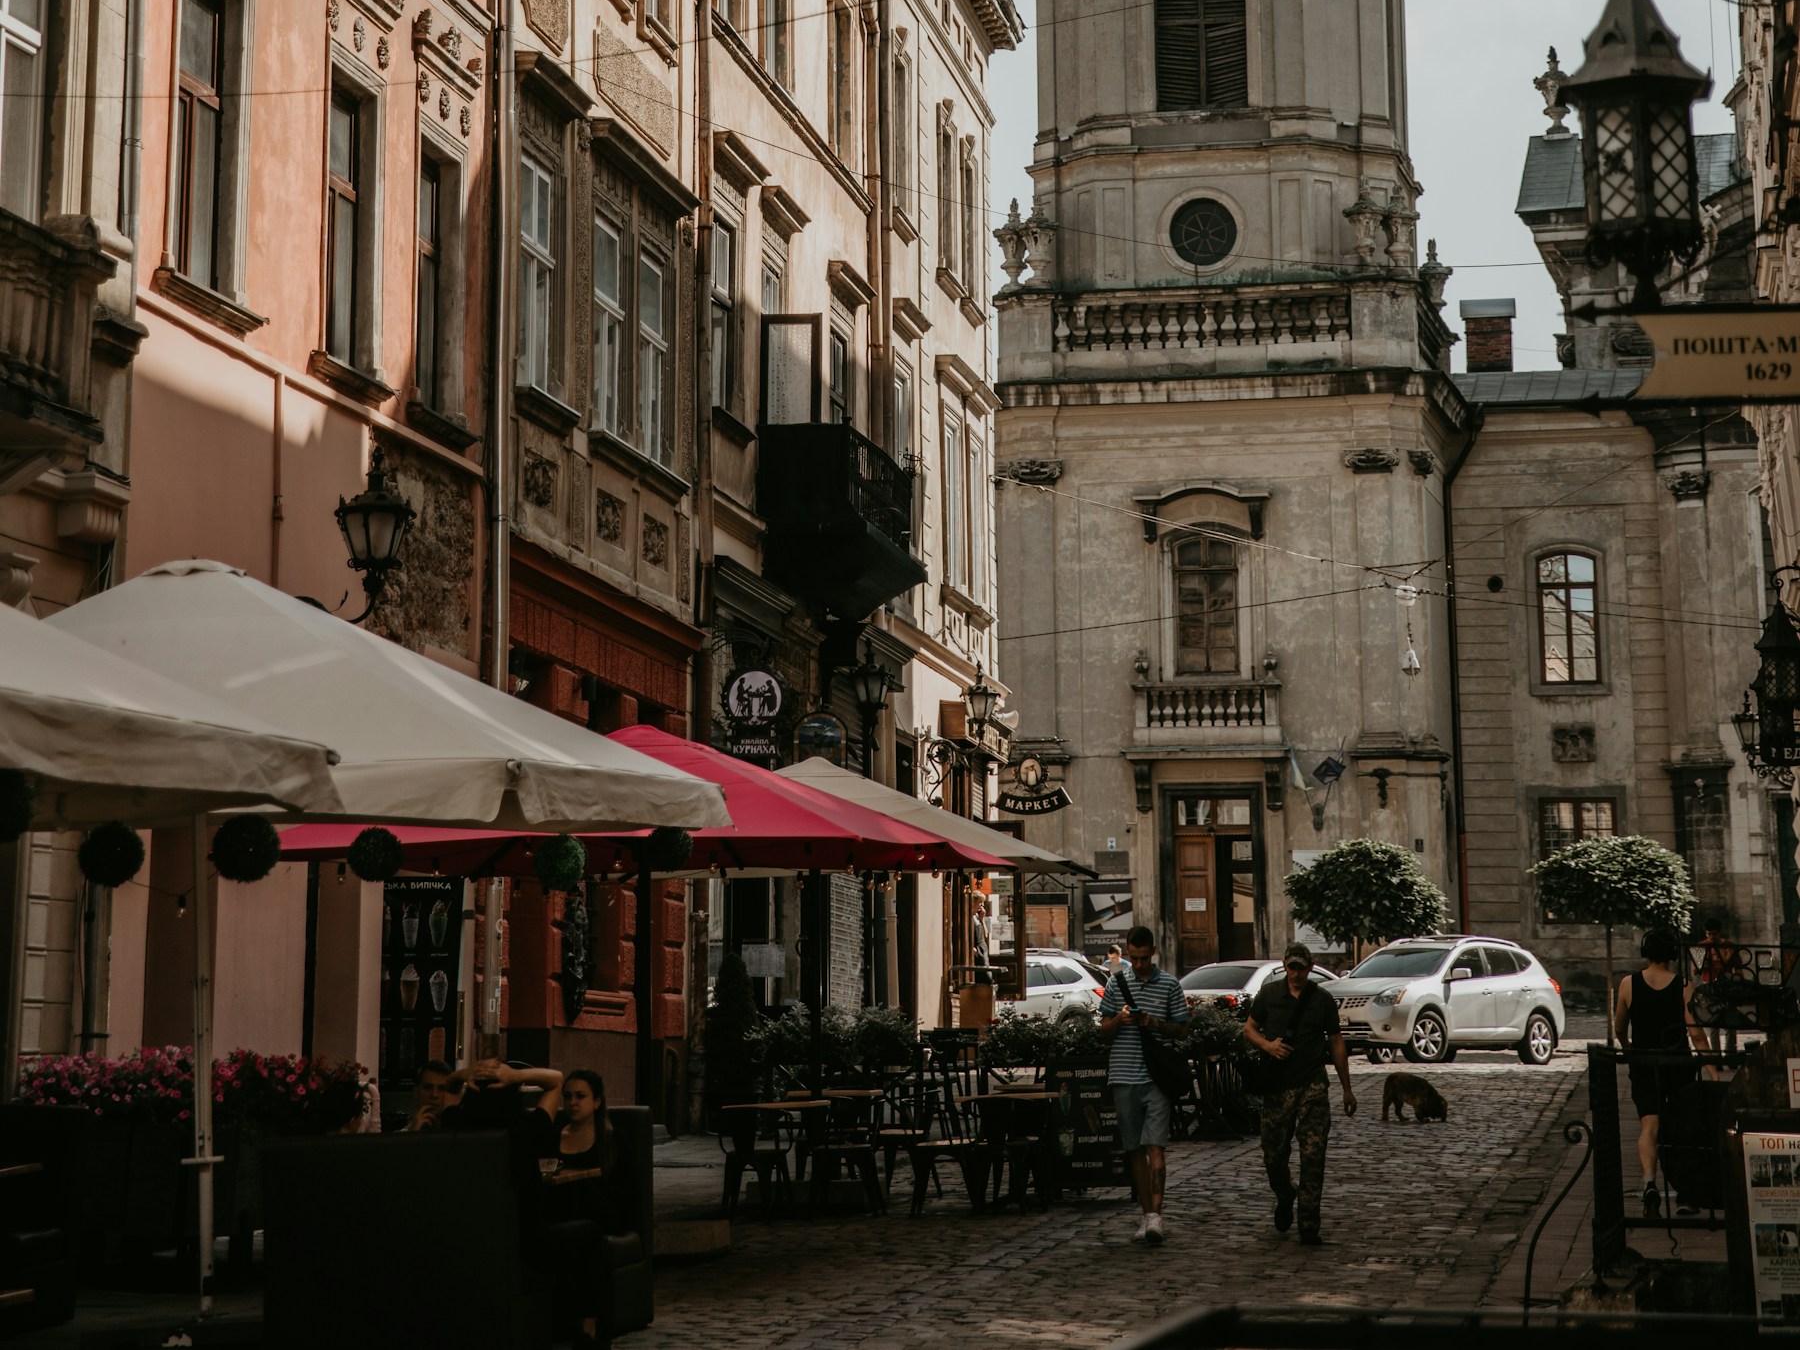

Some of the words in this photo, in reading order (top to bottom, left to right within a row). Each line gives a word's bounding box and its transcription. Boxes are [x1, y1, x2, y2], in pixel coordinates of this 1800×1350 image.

[1673, 336, 1800, 355] ПОШТА·М
[1746, 362, 1792, 380] 1629
[1004, 795, 1060, 811] МАРКЕТ
[410, 881, 452, 890] ВИПІЧКА
[1075, 1069, 1107, 1078] ТРДЕЛЬНИК
[1759, 1136, 1786, 1150] ТОП
